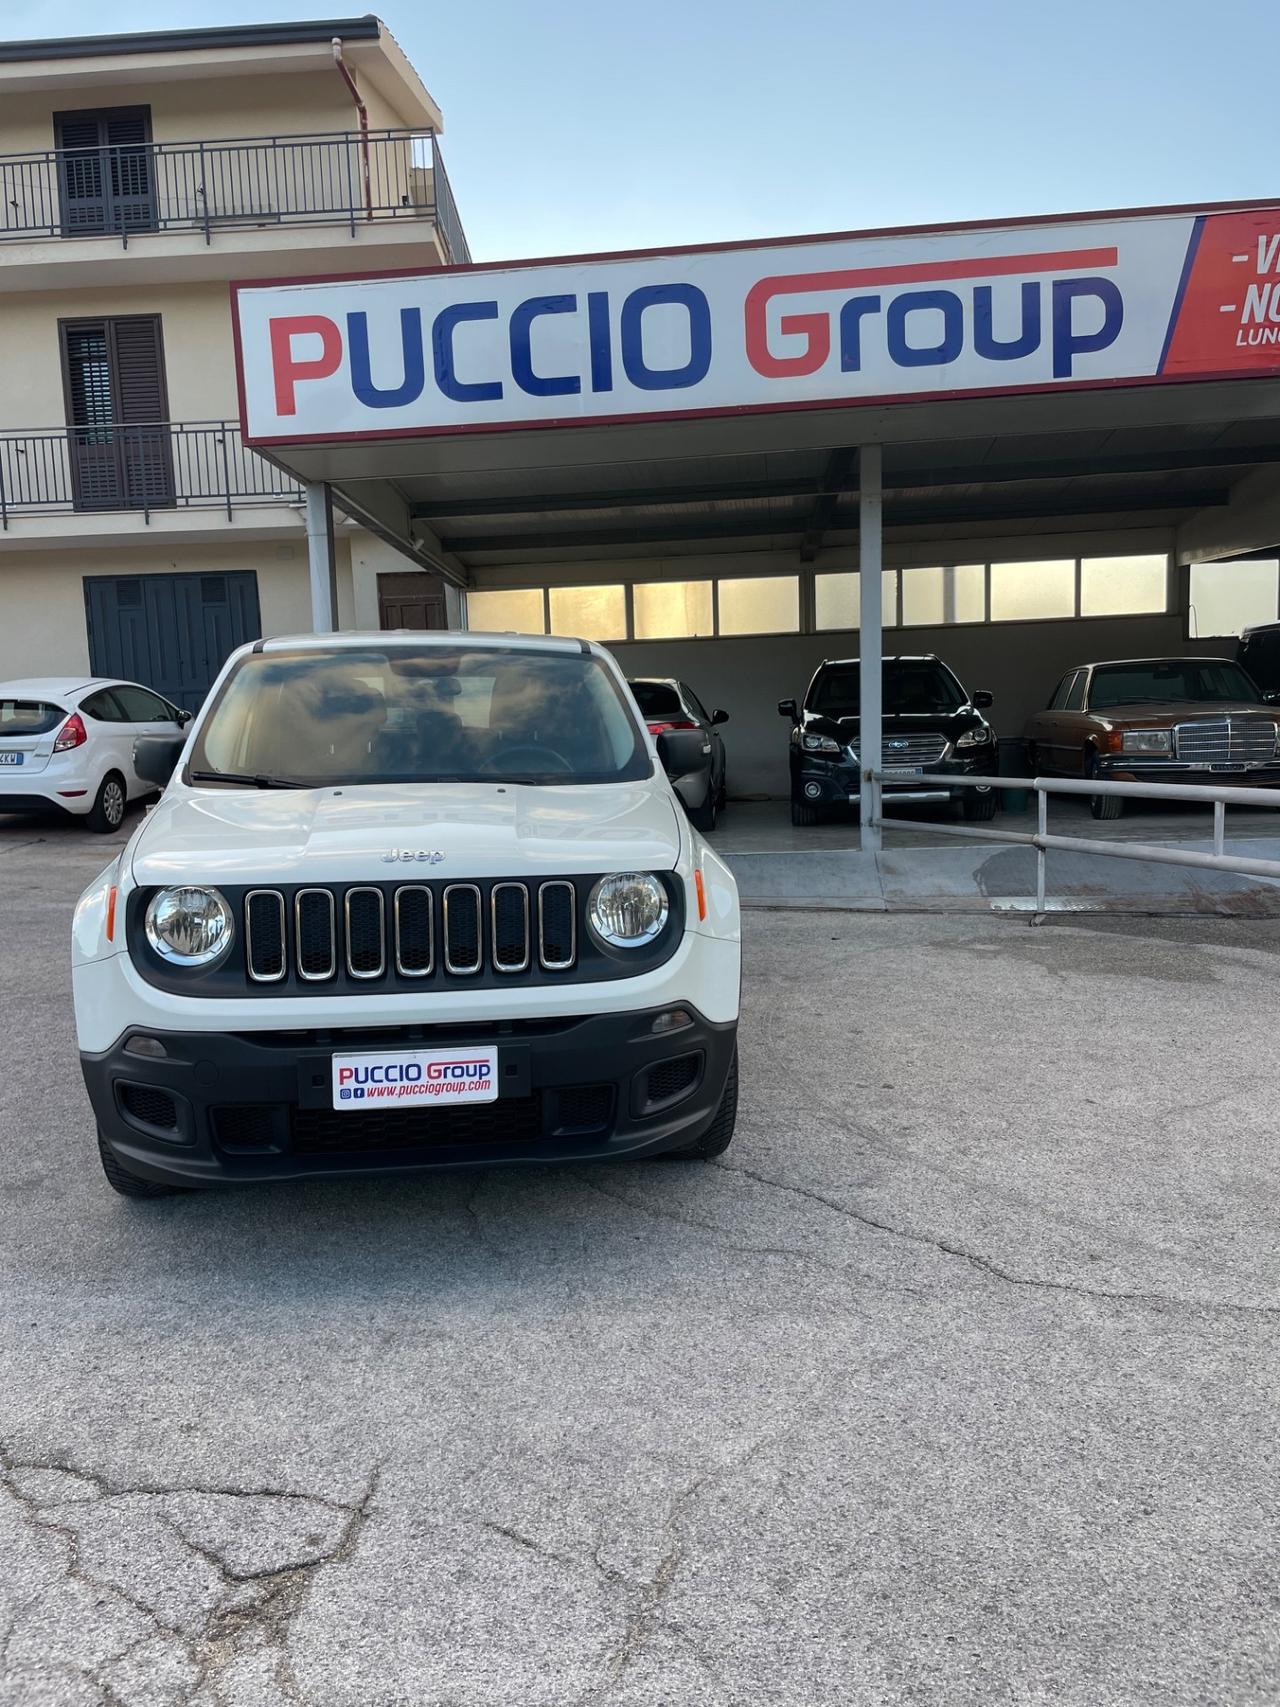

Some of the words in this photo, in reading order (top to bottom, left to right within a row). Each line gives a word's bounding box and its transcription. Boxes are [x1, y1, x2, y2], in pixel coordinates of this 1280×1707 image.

[1236, 327, 1280, 346] LUN
[269, 283, 712, 416] PUCCIO
[381, 849, 445, 865] Jeep
[339, 1063, 422, 1085] PUCCIO
[366, 1079, 491, 1098] www.pucciogroup.com
